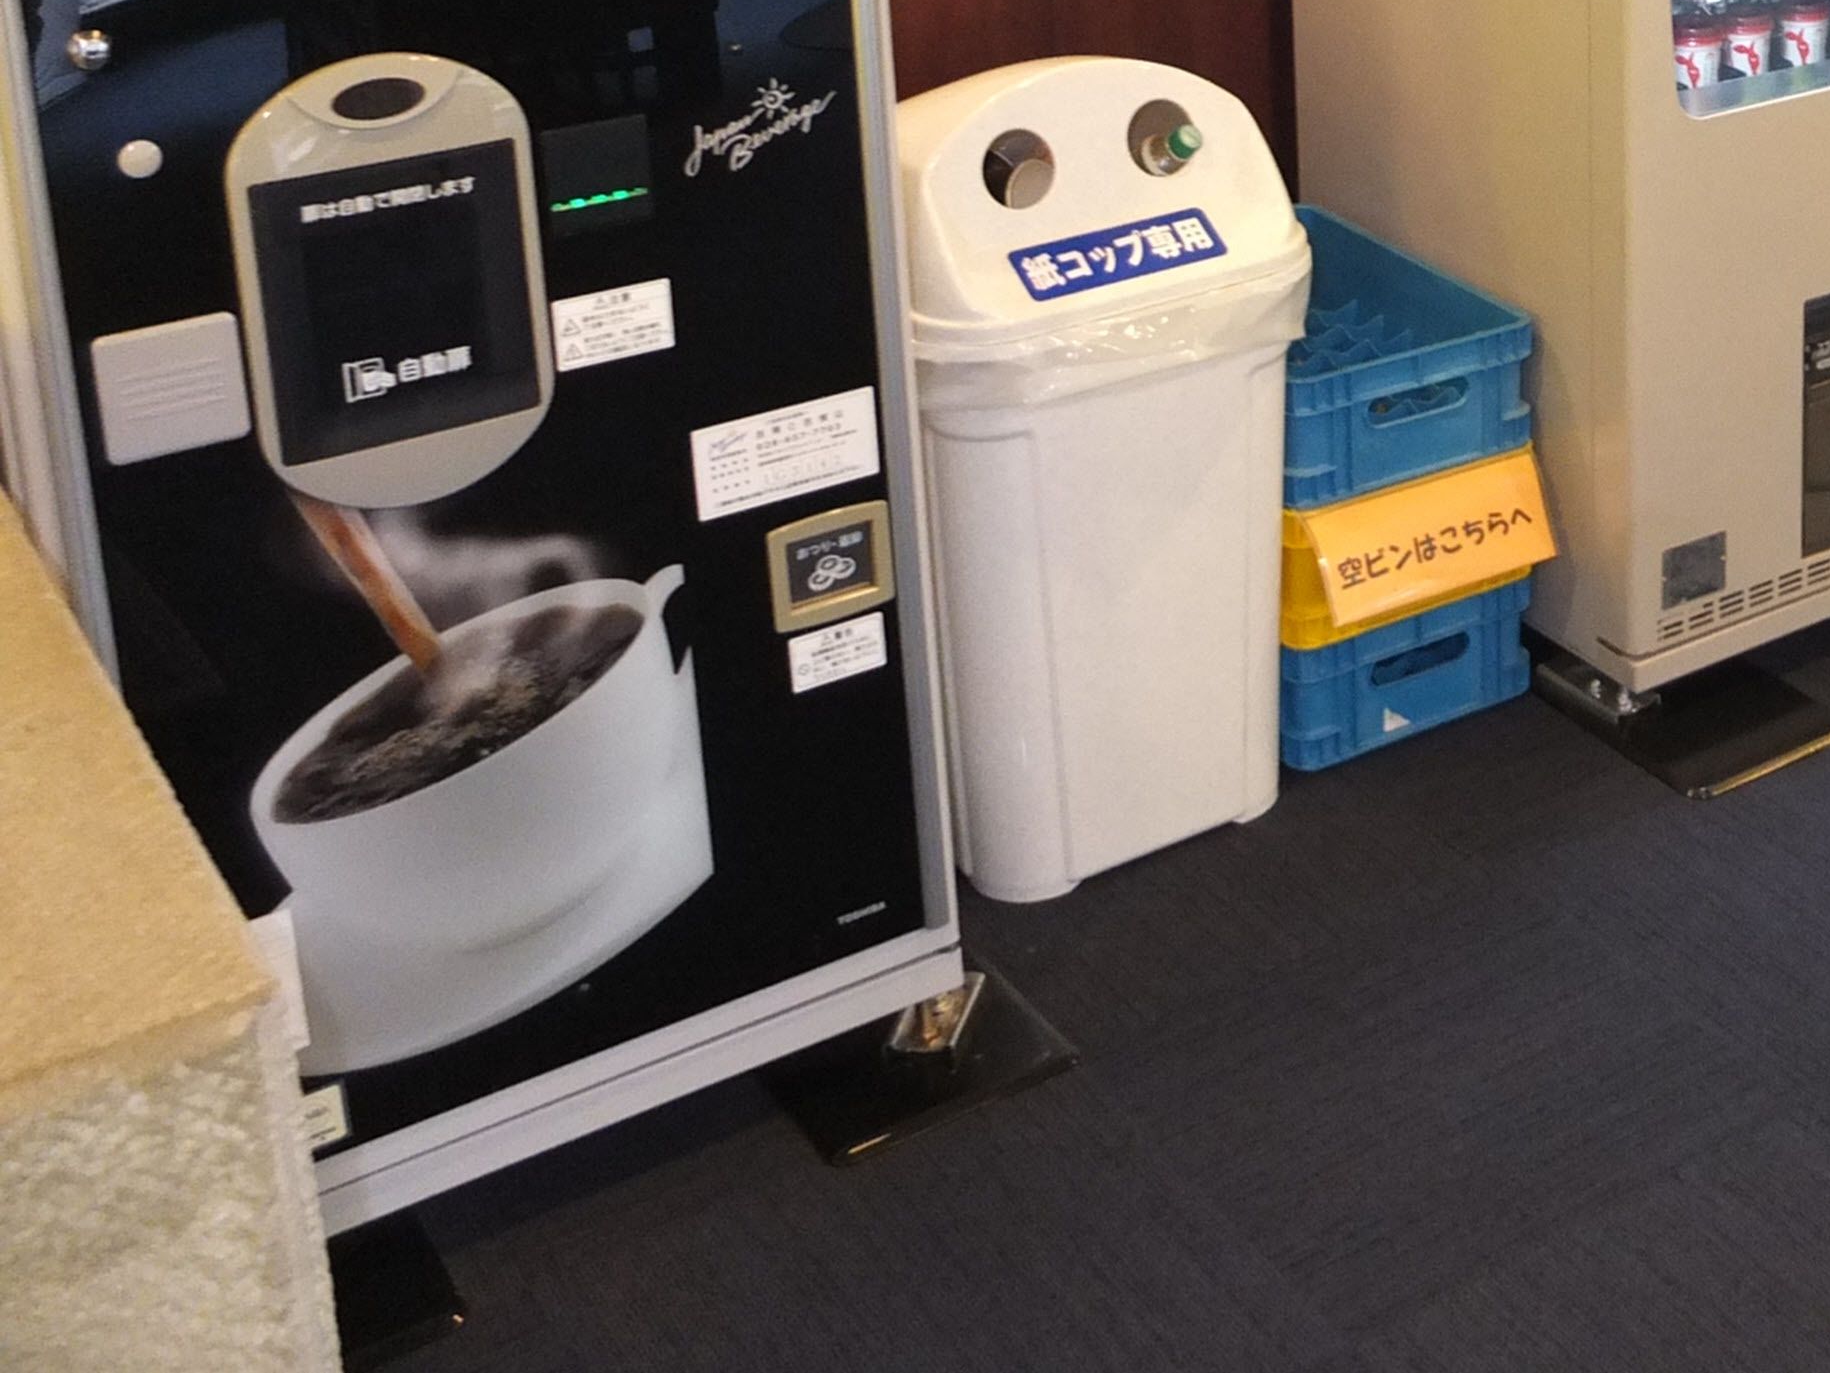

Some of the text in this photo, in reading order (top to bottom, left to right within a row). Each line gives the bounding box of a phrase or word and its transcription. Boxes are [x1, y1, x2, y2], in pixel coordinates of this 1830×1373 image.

[729, 90, 837, 171] Beverage
[1021, 216, 1216, 292] 紙コップ専用
[1336, 507, 1533, 588] 空ビンはこちらへ
